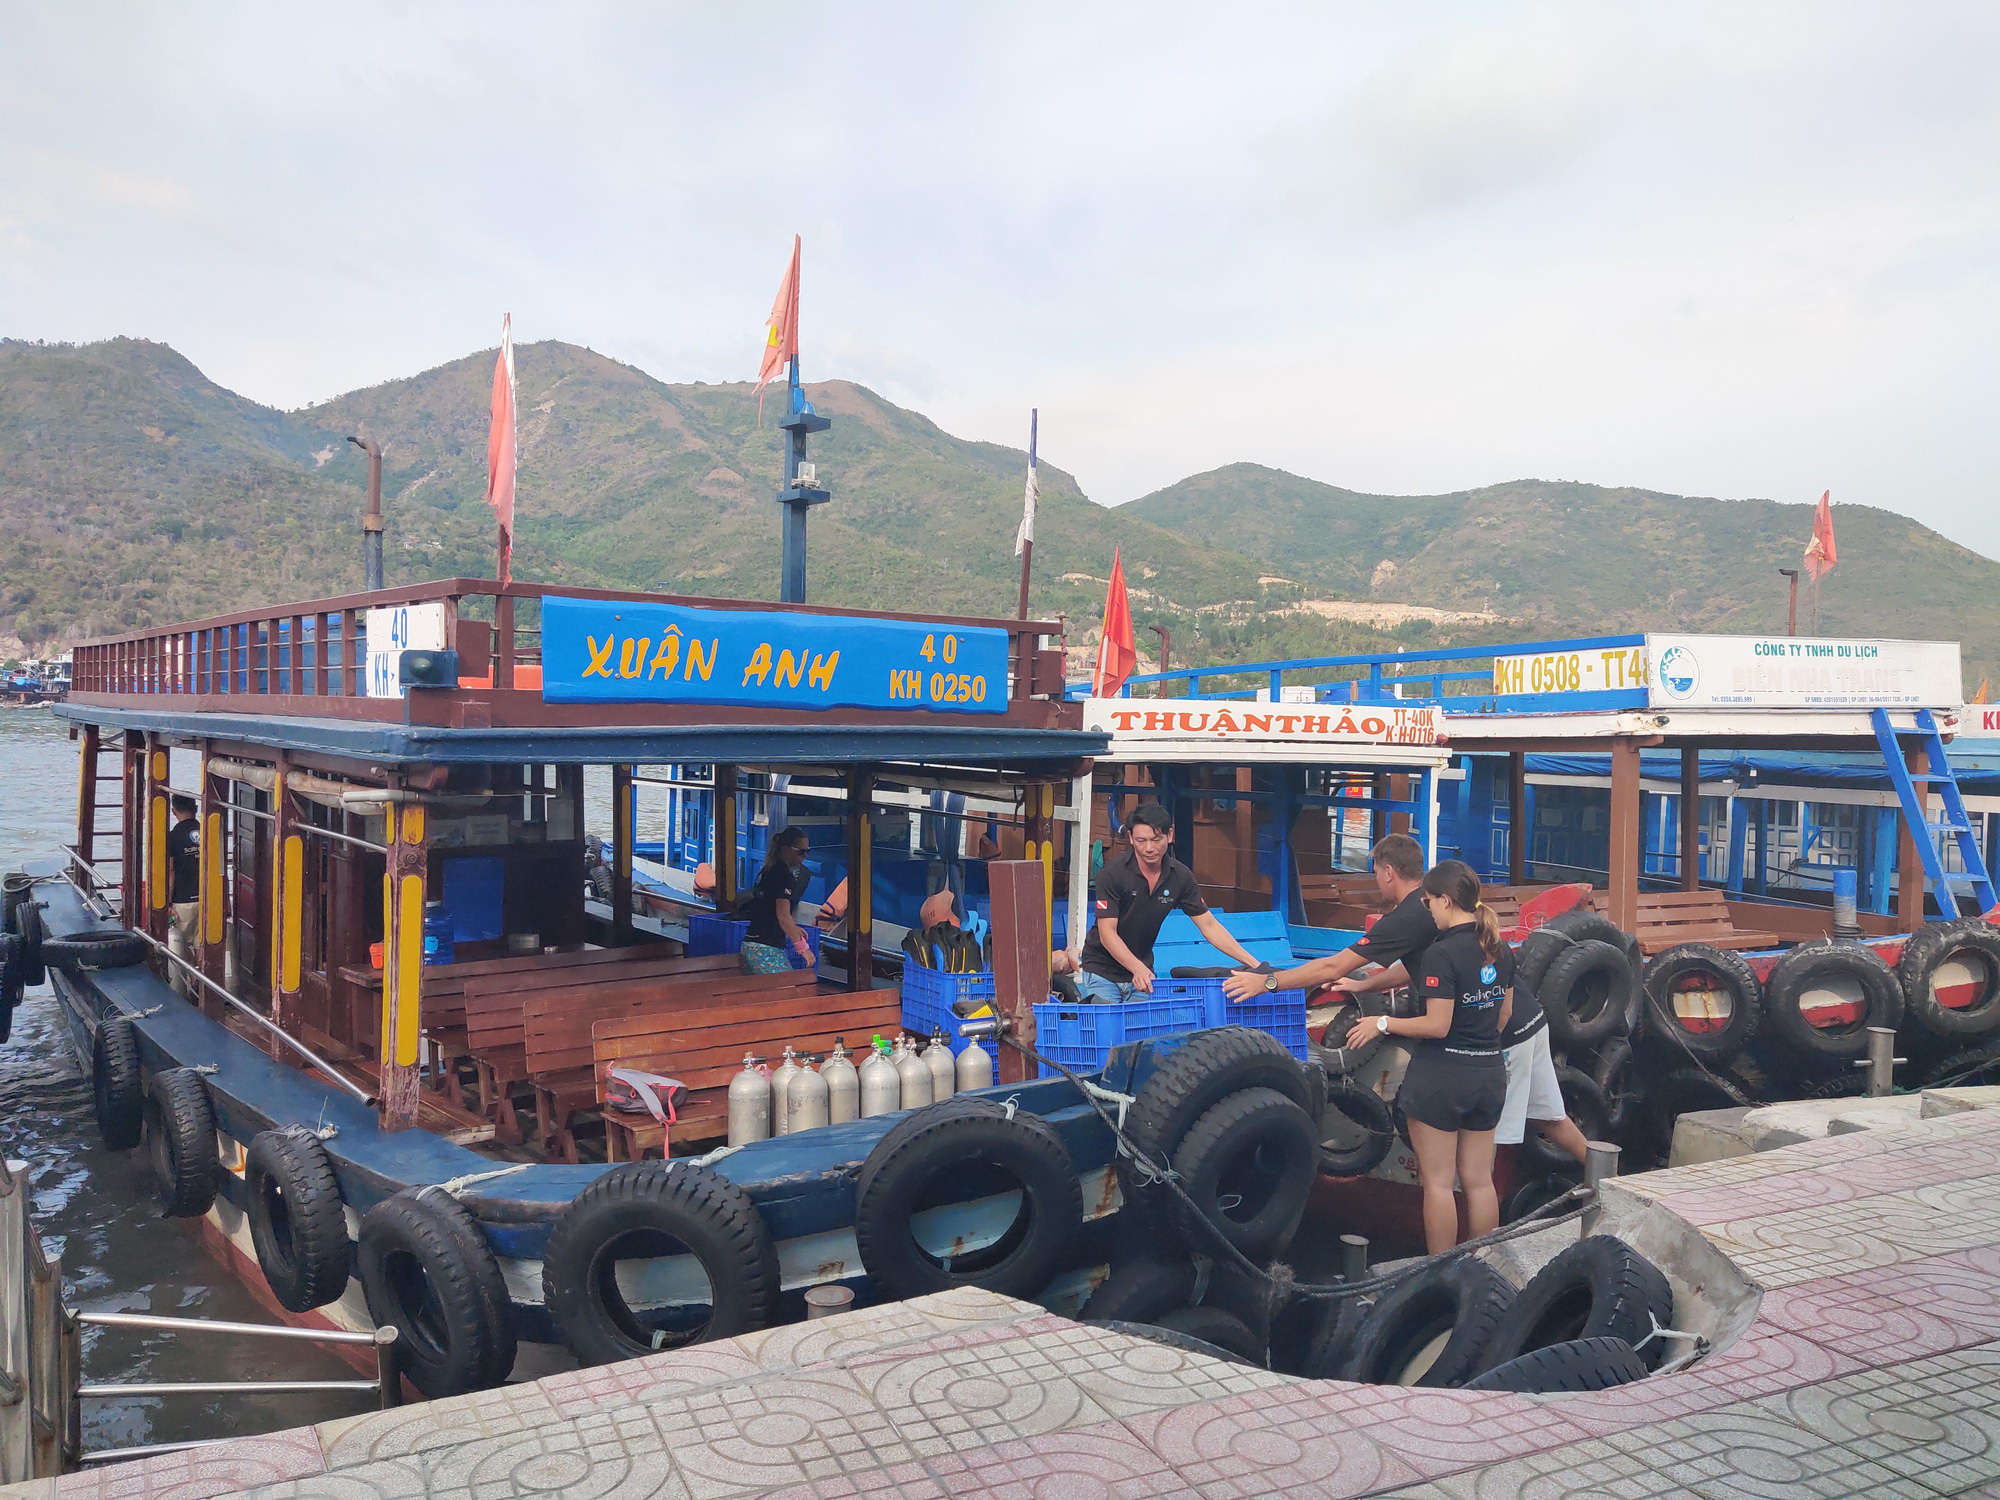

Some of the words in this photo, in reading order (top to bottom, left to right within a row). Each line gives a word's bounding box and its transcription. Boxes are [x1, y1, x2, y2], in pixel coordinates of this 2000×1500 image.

[392, 608, 407, 649] 40
[582, 624, 718, 681] XUÂN
[742, 643, 840, 691] ANH
[1754, 641, 1786, 656] CÔNG
[1789, 644, 1802, 656] TY
[1805, 645, 1834, 657] TNHH
[1838, 645, 1851, 657] DU
[1855, 646, 1878, 660] LỊCH
[890, 669, 922, 699] KH
[930, 672, 986, 702] 0250
[1500, 659, 1524, 693] KH
[1531, 654, 1580, 692] 0508
